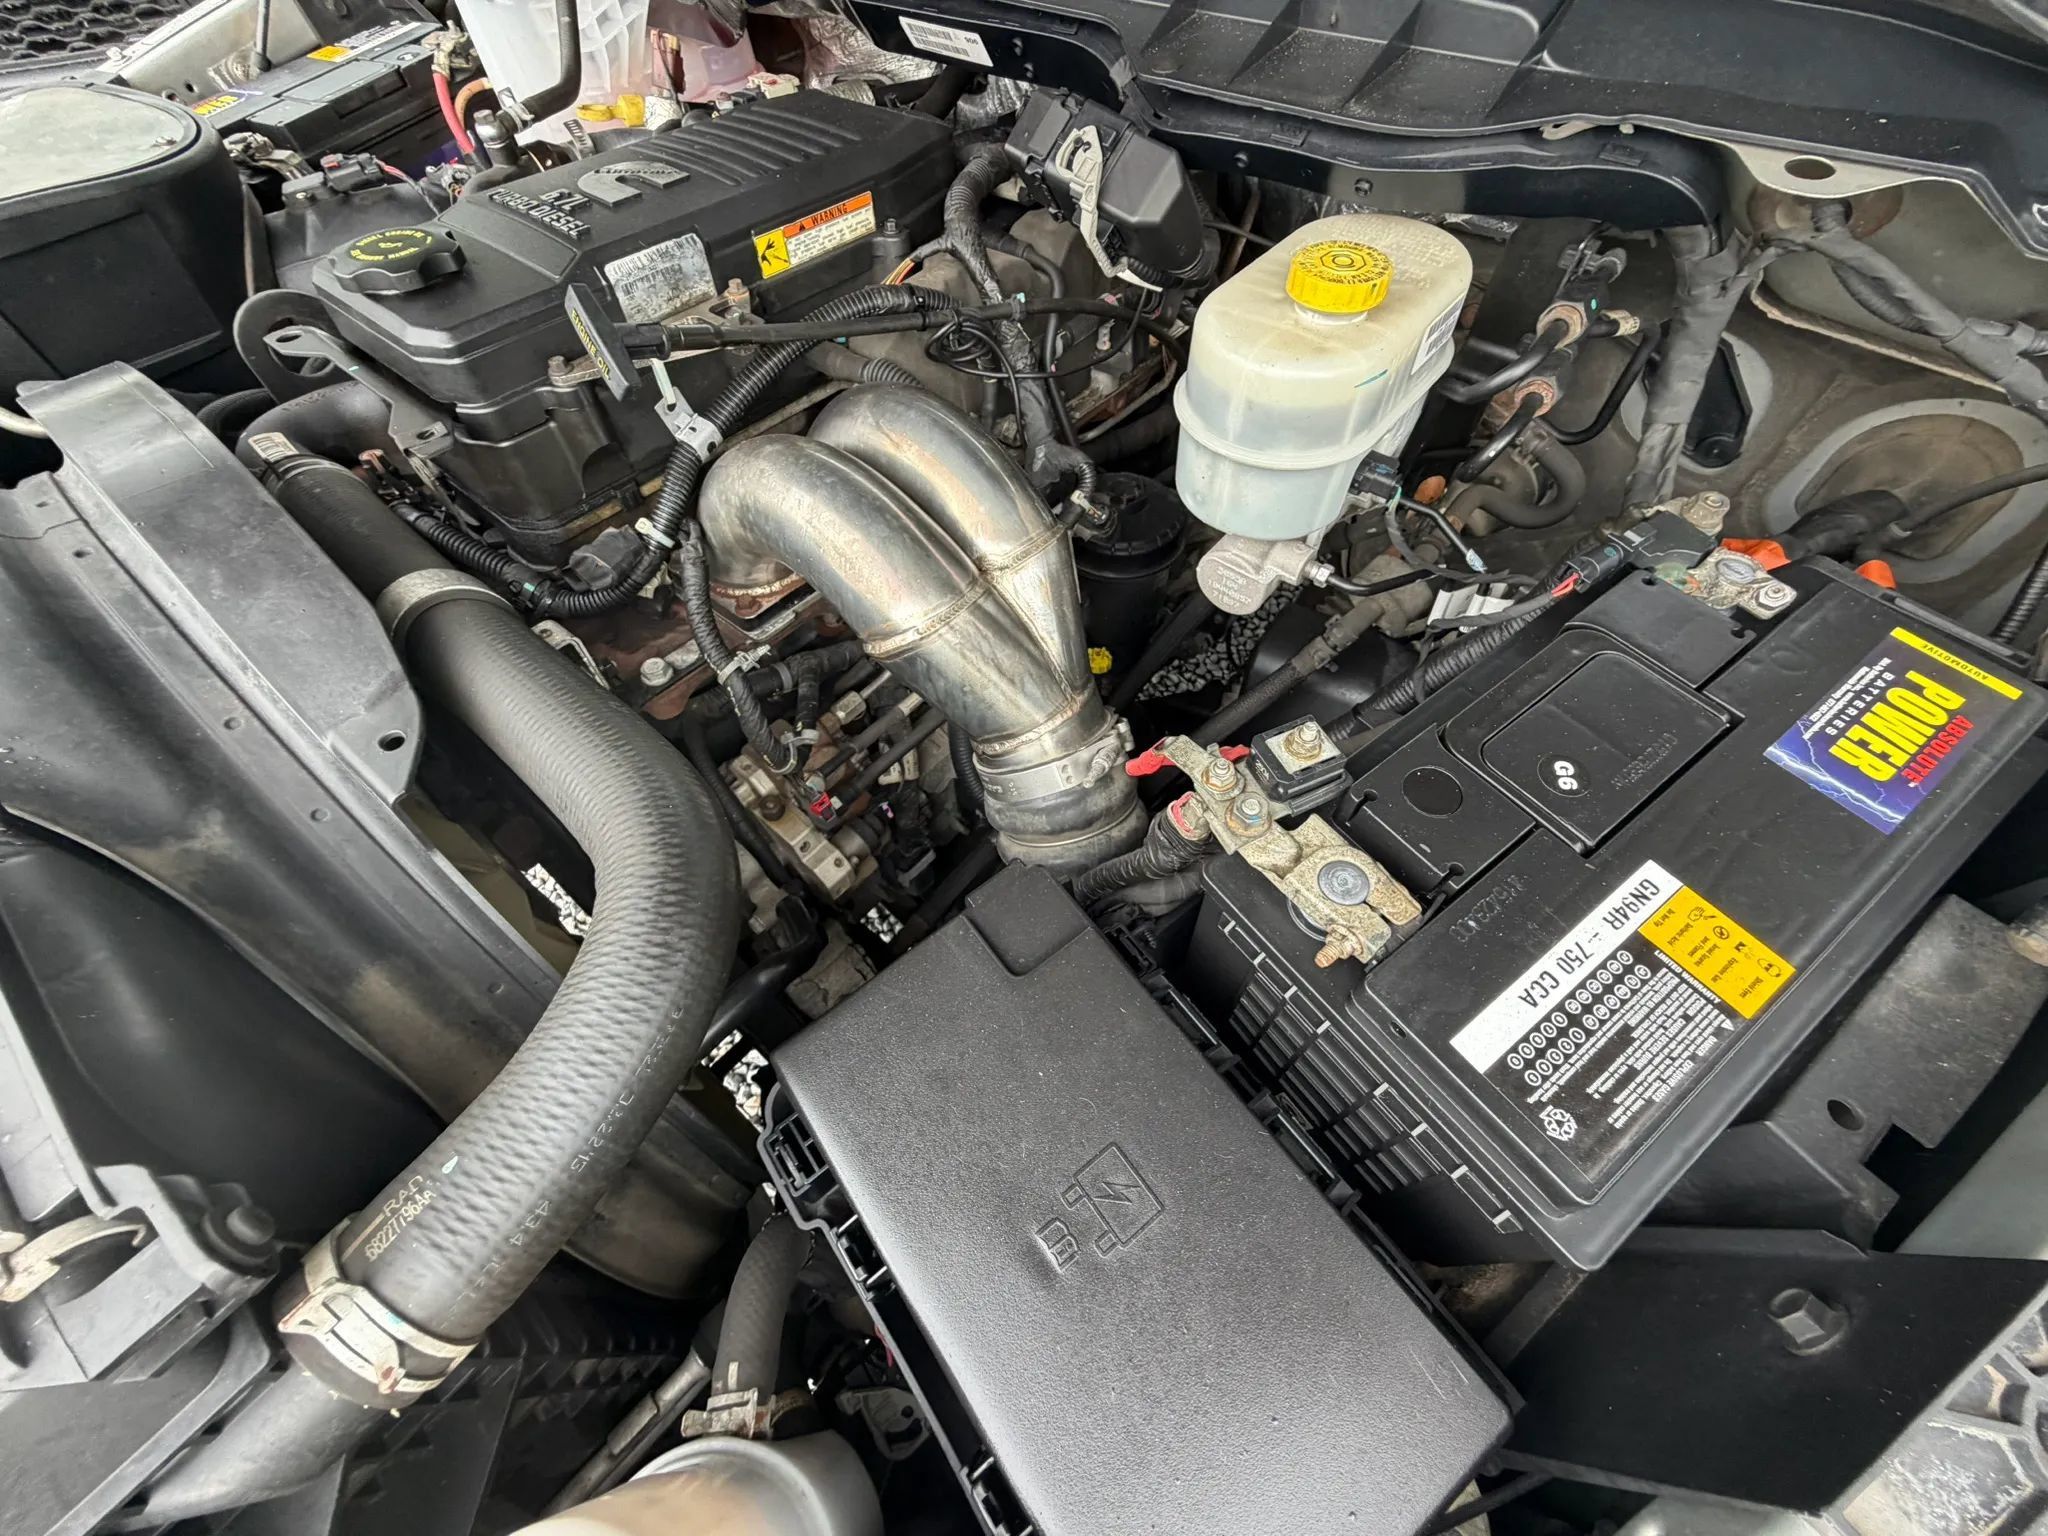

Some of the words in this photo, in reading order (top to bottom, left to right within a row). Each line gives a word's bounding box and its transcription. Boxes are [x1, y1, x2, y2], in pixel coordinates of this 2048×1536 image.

[488, 188, 532, 213] TURBO
[529, 202, 592, 240] DIESEL
[810, 203, 848, 226] WARNING
[570, 307, 601, 357] ENGINE
[596, 355, 612, 381] OIL
[1920, 641, 1988, 680] AUTOMOTIVE
[1824, 670, 1895, 736] BATTERIES
[1828, 670, 1966, 782] POWER
[1899, 715, 1975, 784] ABSOLUTE
[1553, 760, 1578, 790] G6
[1601, 878, 1661, 931] GN94R
[1553, 940, 1594, 974] 750
[1516, 970, 1561, 1009] CCA
[1653, 949, 1681, 973] LIMITED
[1680, 970, 1720, 1004] WARRANTY
[1647, 1034, 1669, 1054] SEVERE
[1664, 1017, 1686, 1037] CAUSES
[1694, 1034, 1717, 1056] DANGER
[1632, 1050, 1652, 1070] BURNS
[1665, 1058, 1694, 1087] EXPLOSIVE
[1650, 1083, 1670, 1102] GASES
